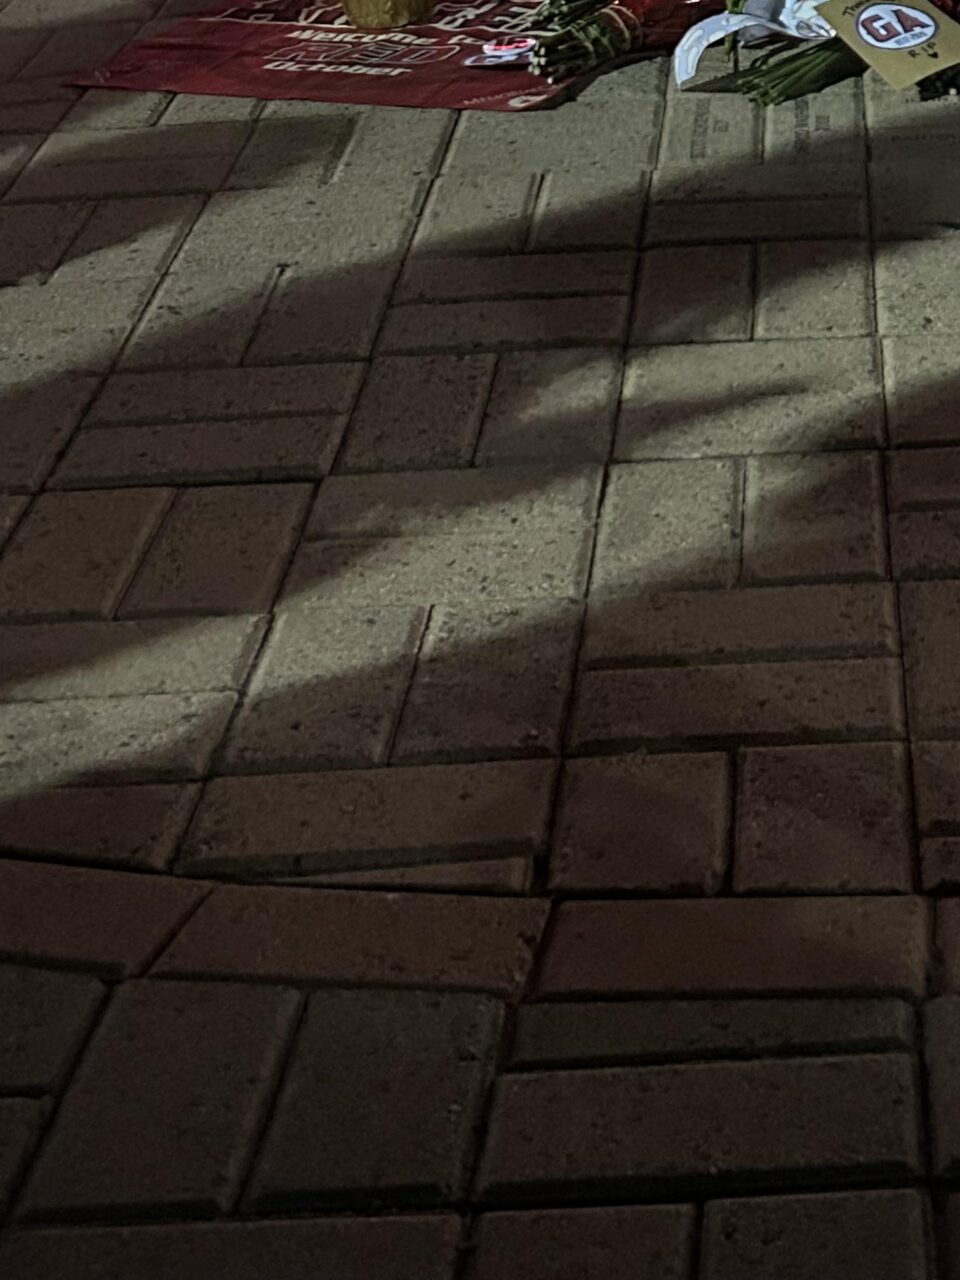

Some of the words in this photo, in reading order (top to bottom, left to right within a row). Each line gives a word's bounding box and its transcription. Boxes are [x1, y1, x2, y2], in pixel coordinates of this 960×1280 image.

[861, 9, 932, 42] GA
[286, 29, 439, 45] Welcome
[262, 61, 412, 76] October
